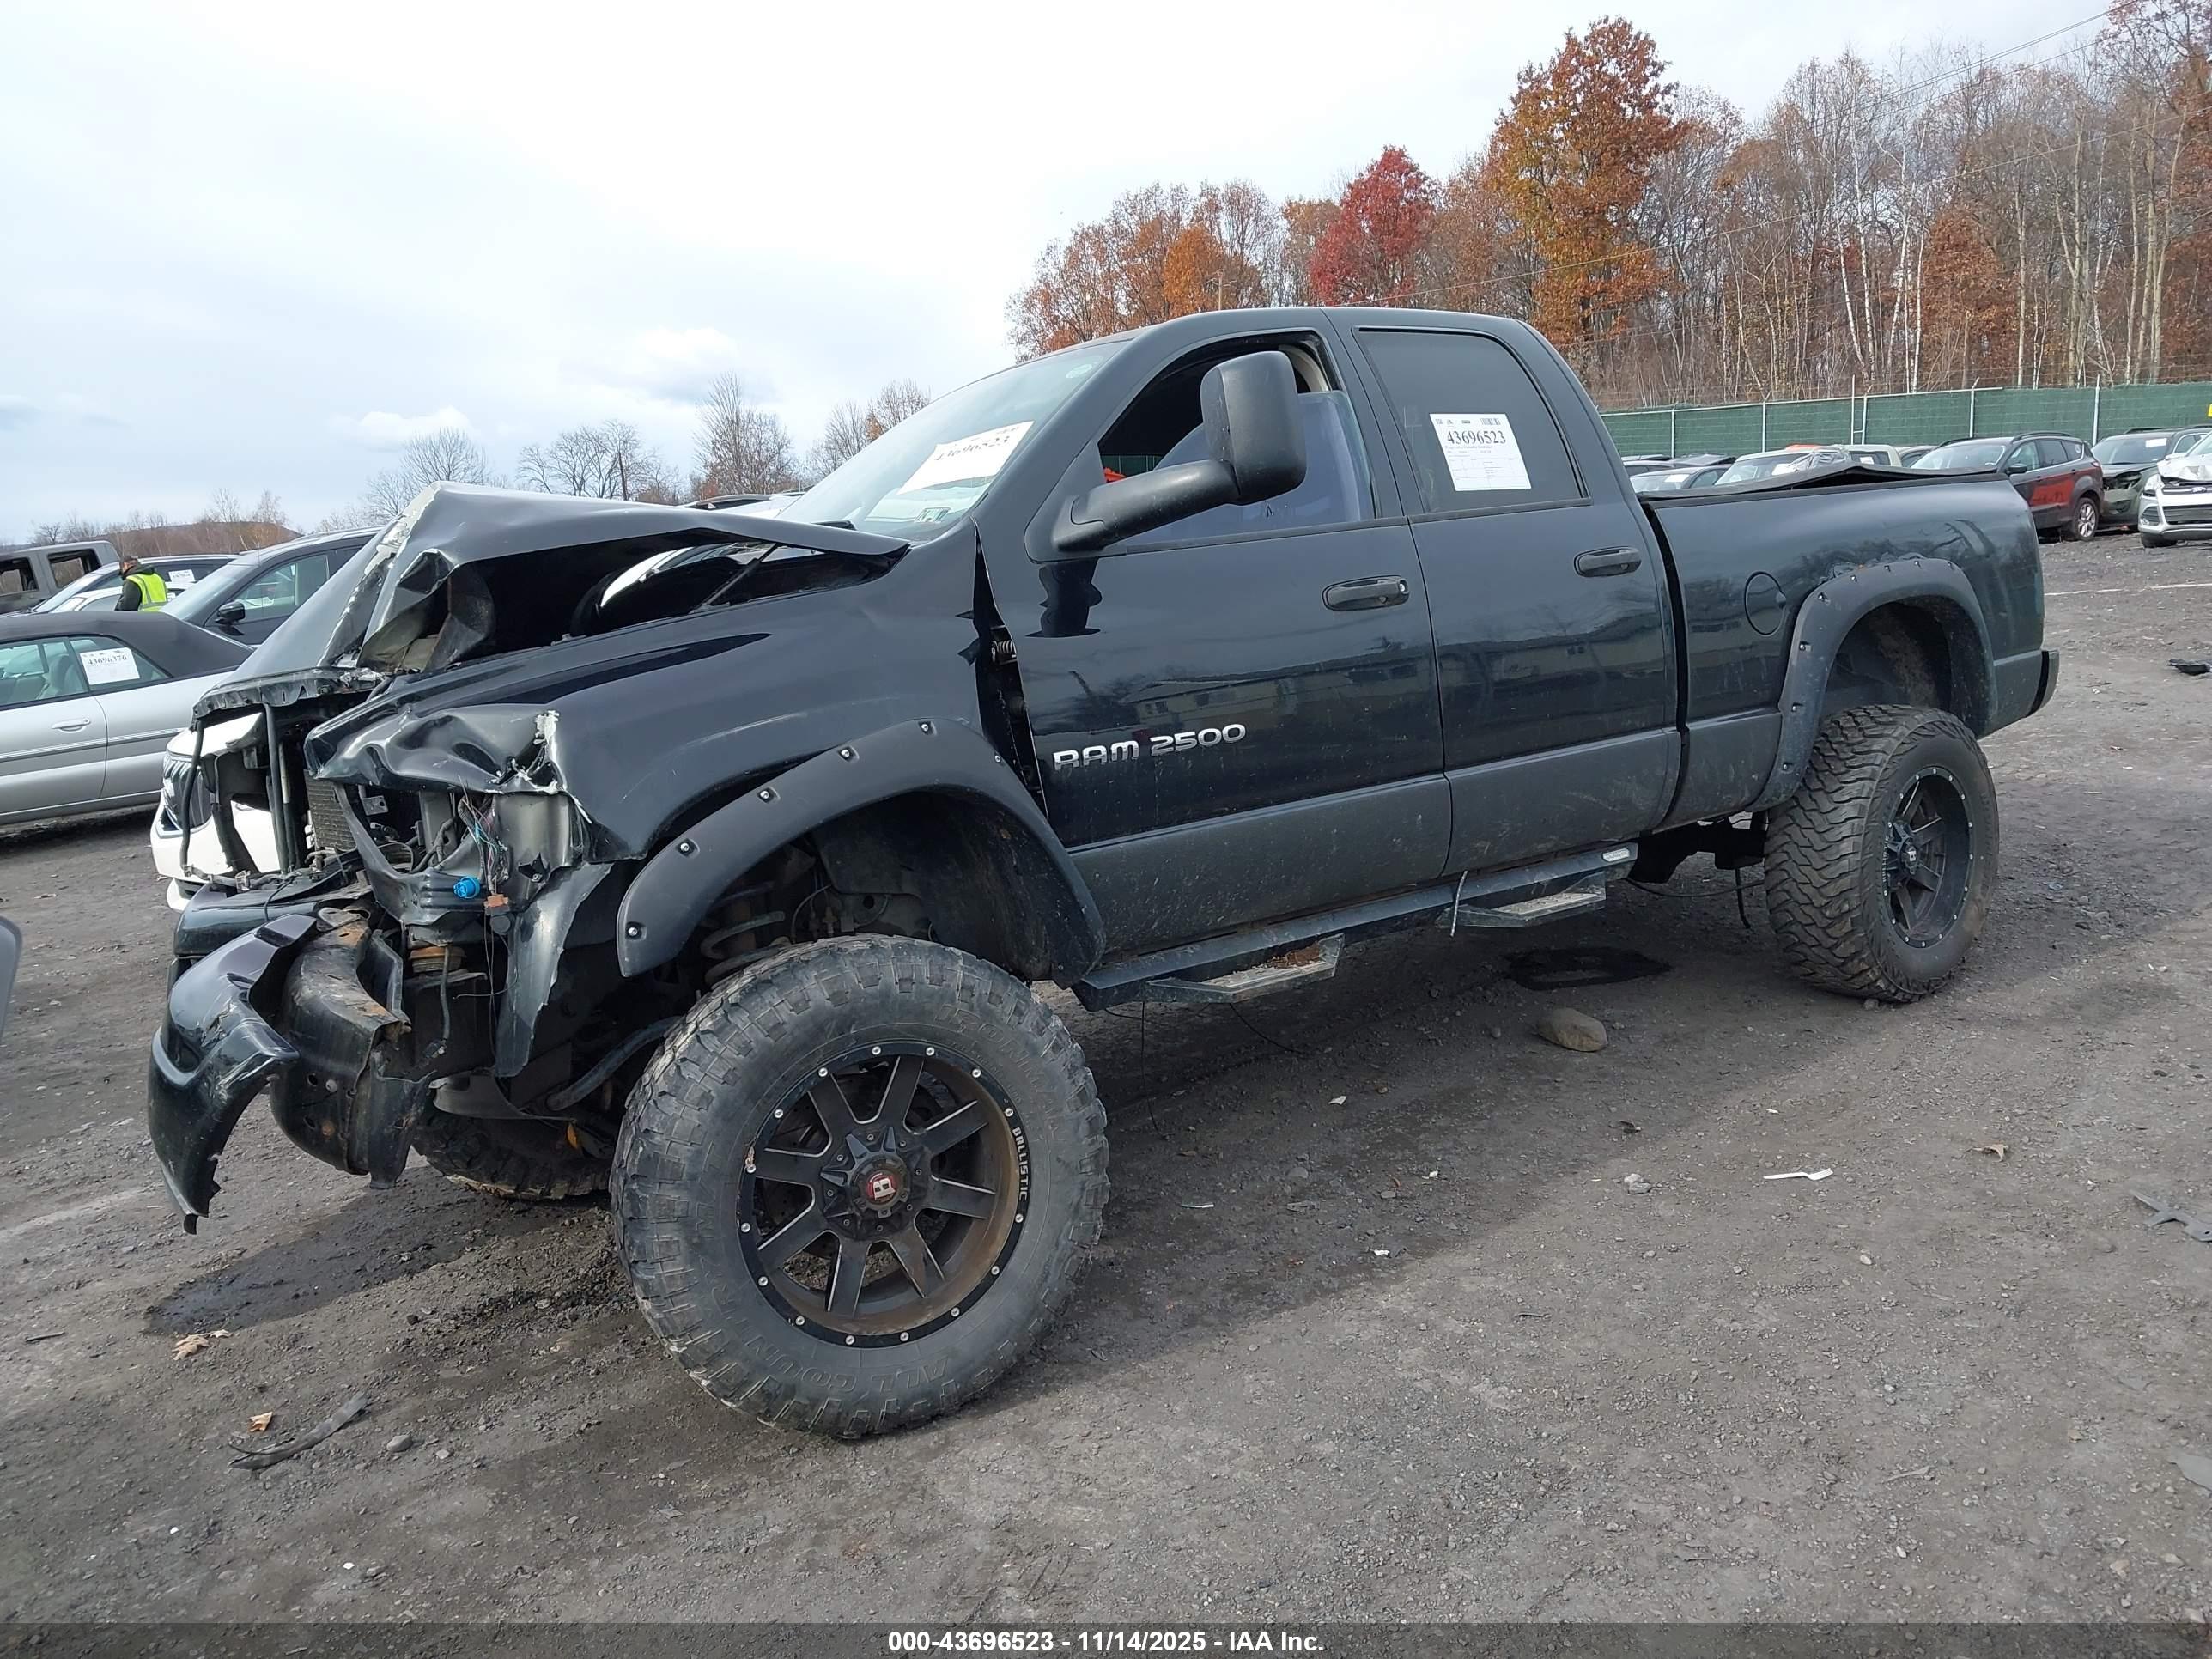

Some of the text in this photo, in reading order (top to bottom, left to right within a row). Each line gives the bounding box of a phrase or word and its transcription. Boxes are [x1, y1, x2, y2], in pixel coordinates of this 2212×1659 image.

[1447, 430, 1506, 445] 43696523
[1053, 723, 1246, 770] RAM 2500
